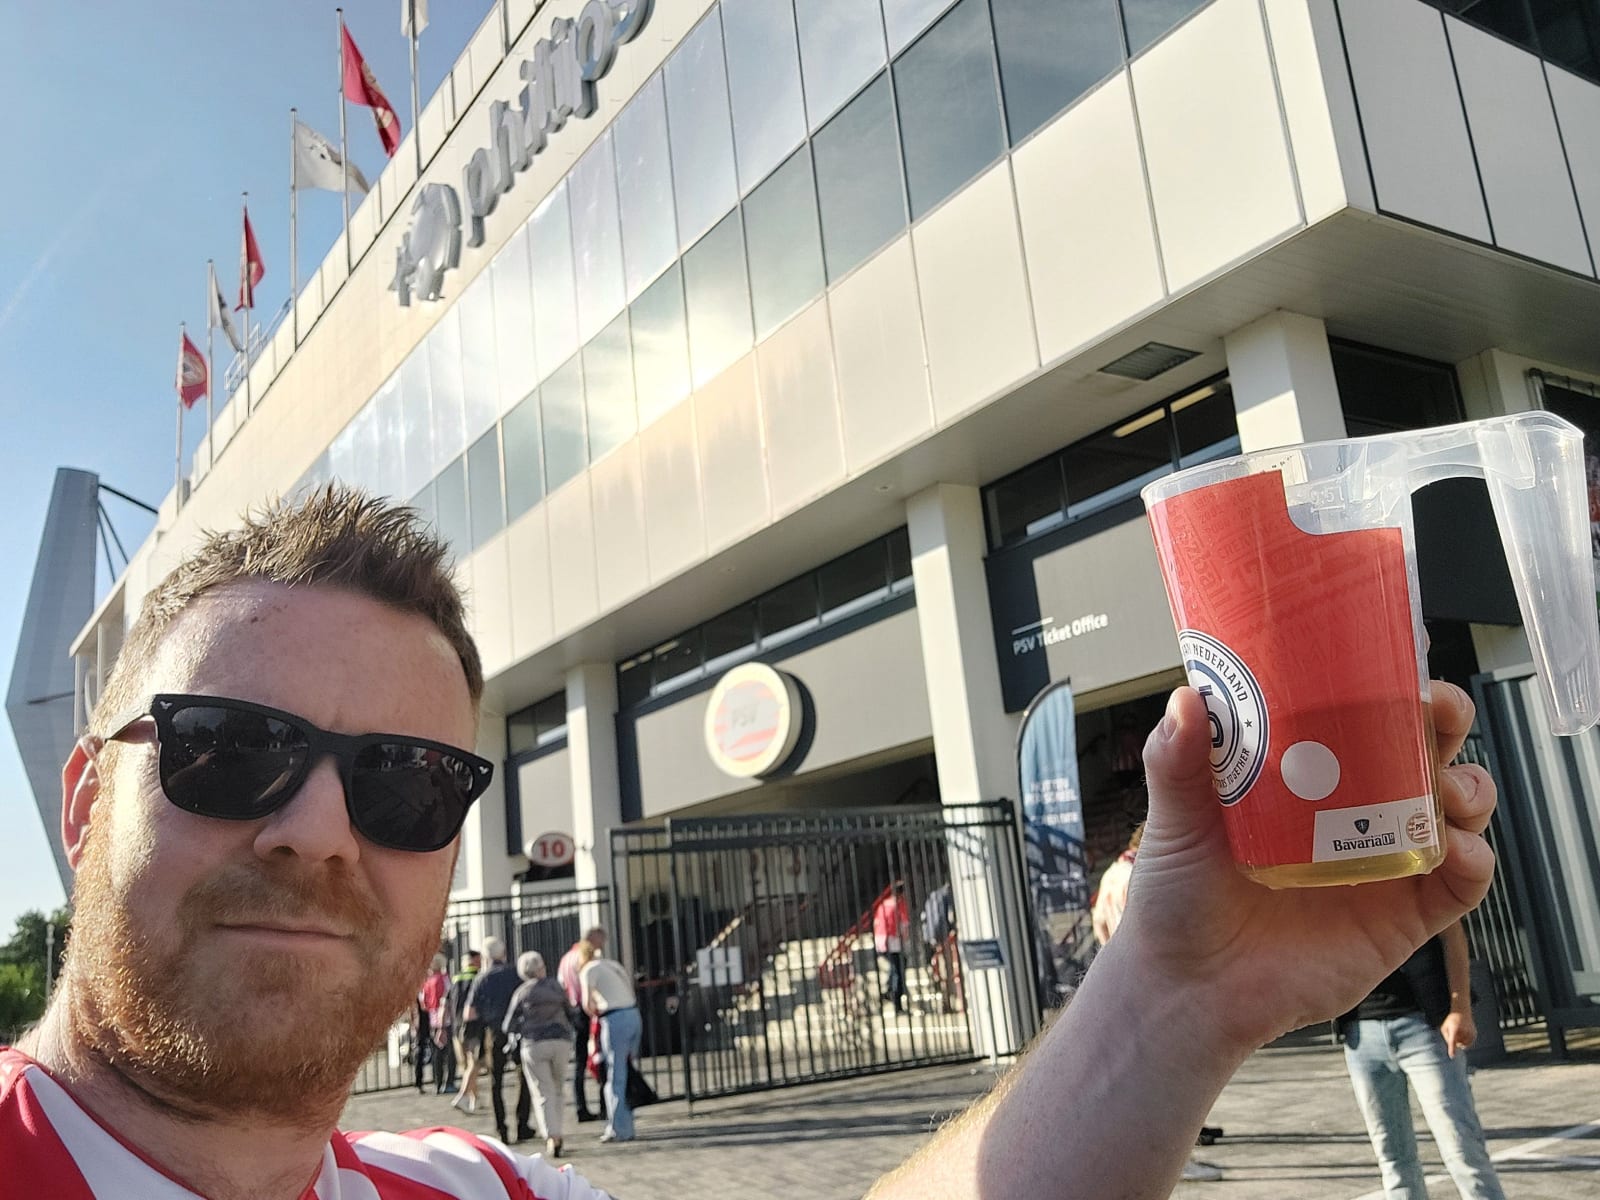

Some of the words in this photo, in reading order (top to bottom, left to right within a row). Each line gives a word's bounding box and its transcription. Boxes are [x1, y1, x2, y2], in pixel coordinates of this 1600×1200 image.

[1012, 635, 1036, 656] PSV
[1036, 624, 1072, 648] Ticket
[1072, 613, 1108, 636] Office
[1192, 643, 1249, 702] NEDERLAND
[1226, 747, 1251, 785] TOGETHER
[539, 840, 566, 859] 10
[1333, 836, 1383, 851] Bavaria
